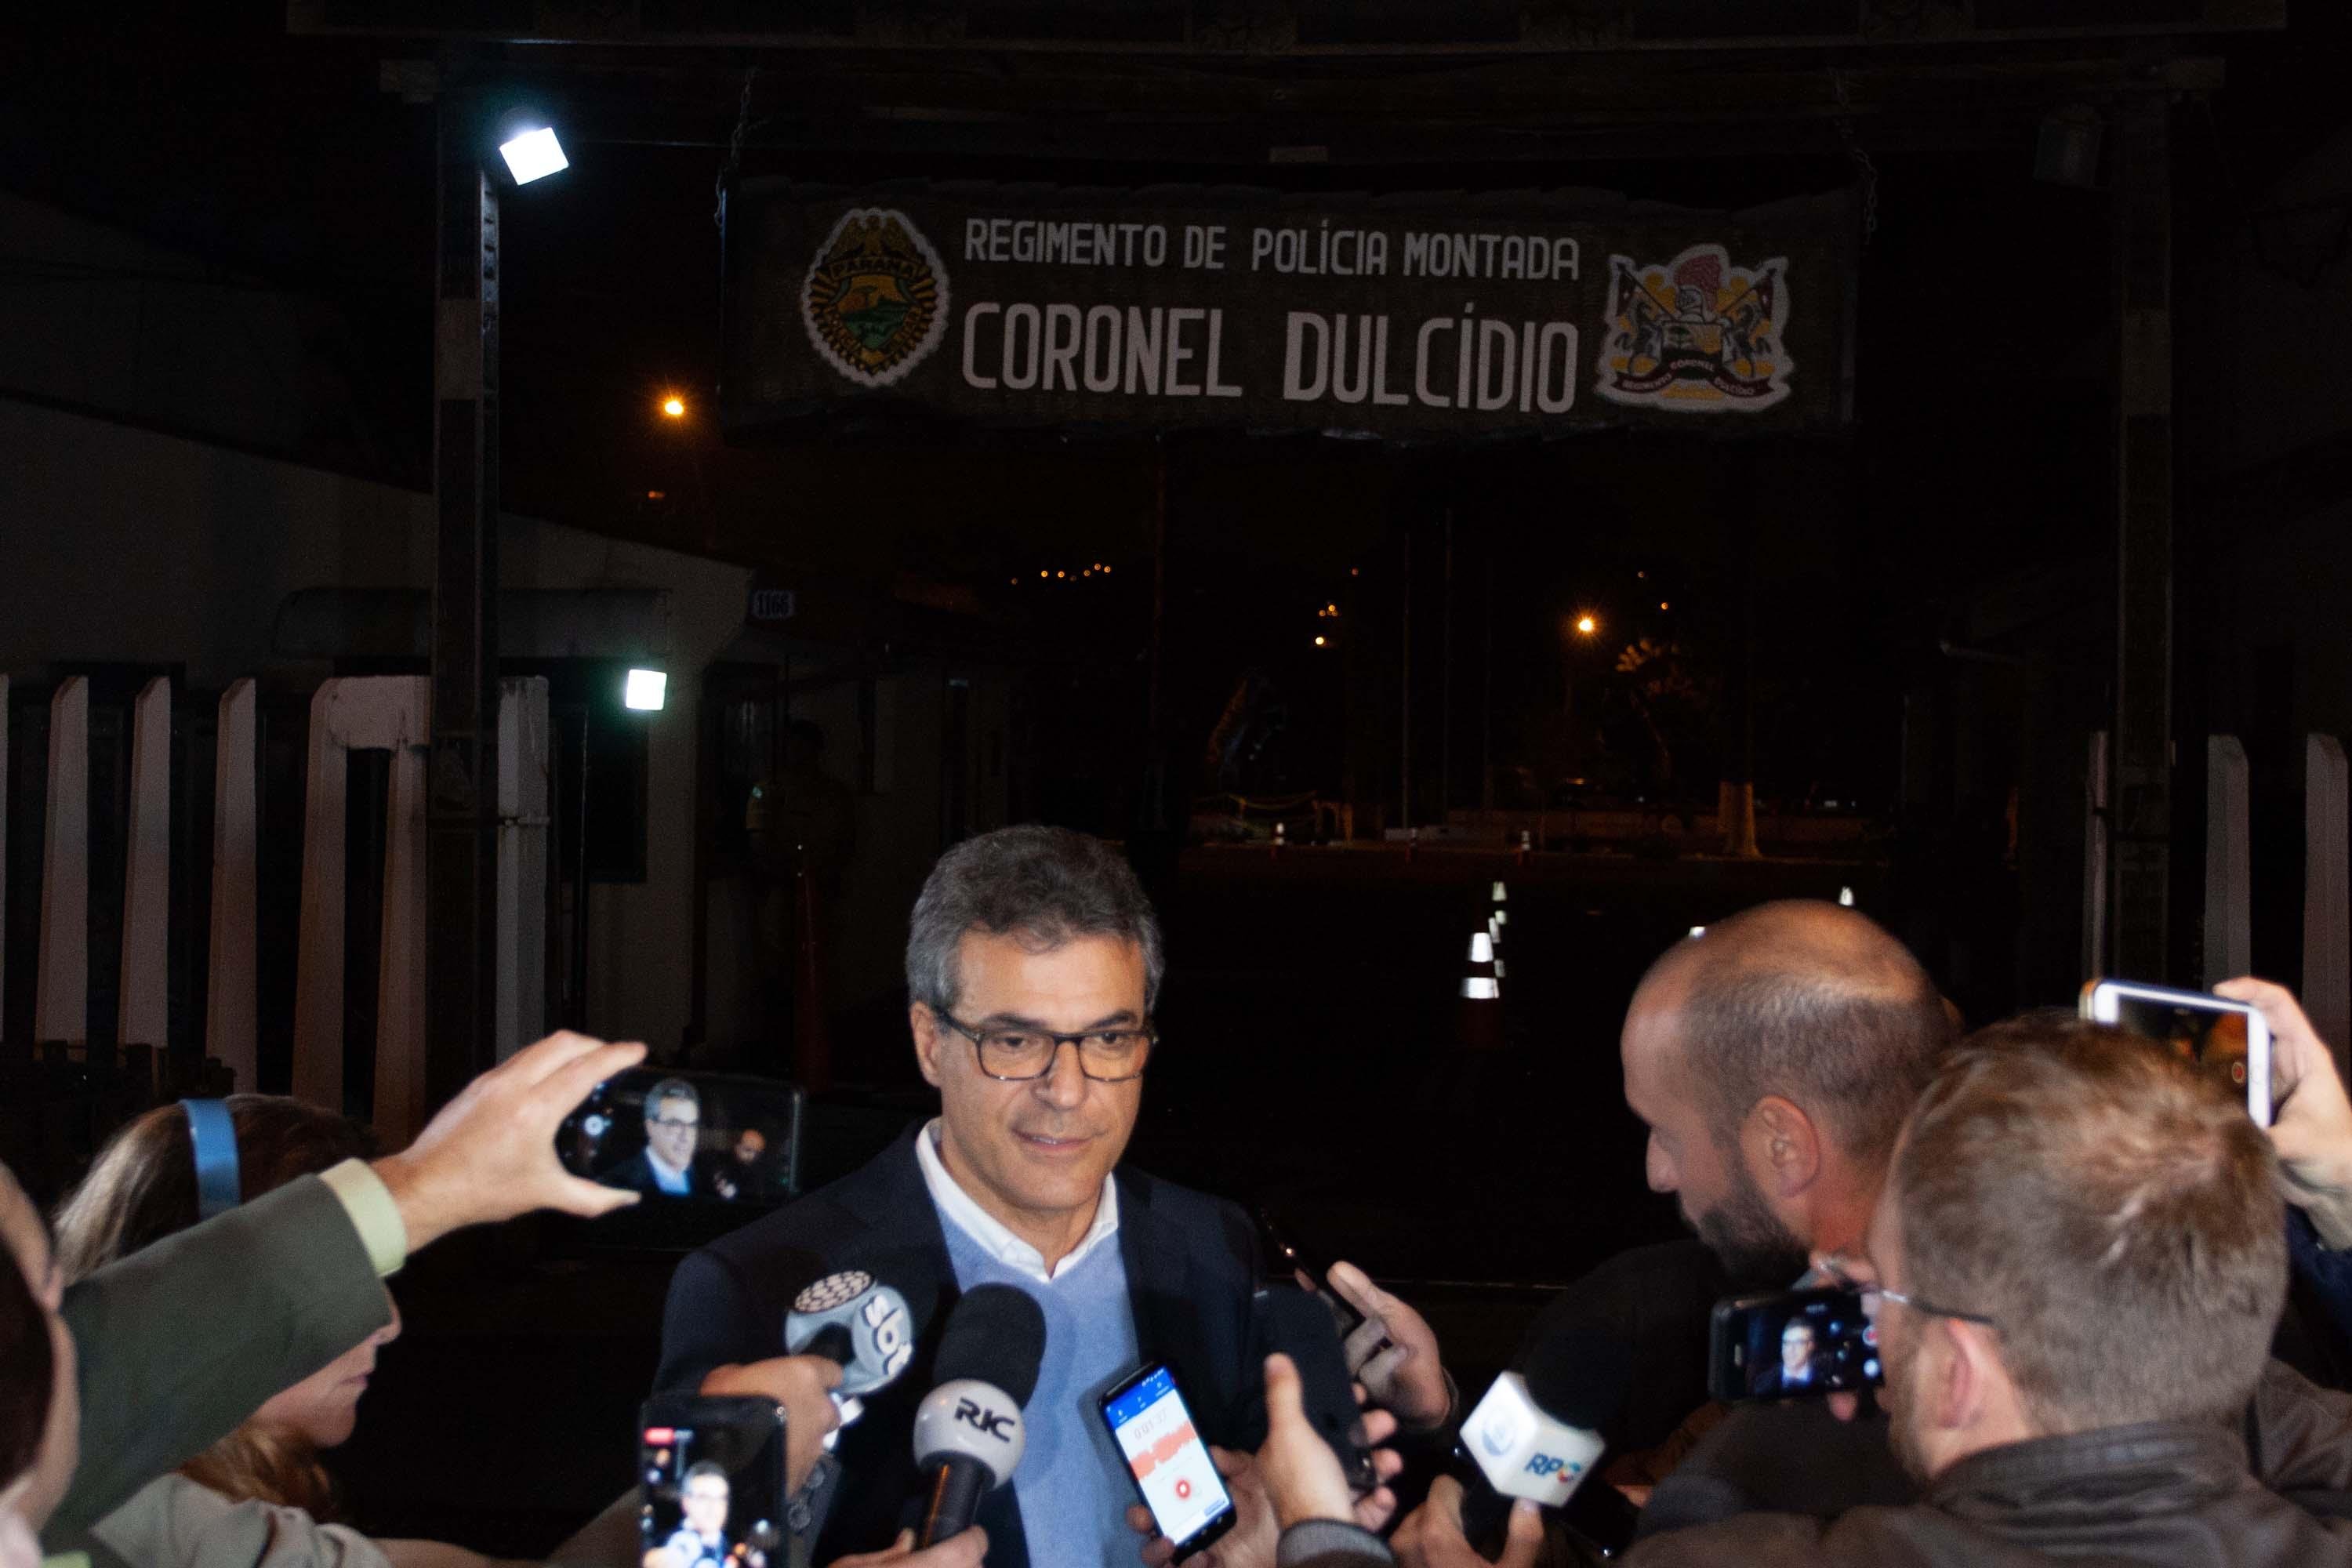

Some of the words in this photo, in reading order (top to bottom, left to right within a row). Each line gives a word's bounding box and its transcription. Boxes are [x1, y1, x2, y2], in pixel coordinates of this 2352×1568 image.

[966, 220, 1166, 266] REGIMENTO
[1185, 226, 1225, 268] DE
[1252, 220, 1387, 274] POLÍCIA
[1403, 233, 1578, 279] MONTADA
[963, 303, 1242, 397] CORONEL
[1283, 303, 1578, 413] DULCÍDIO
[954, 1398, 1014, 1443] RIC
